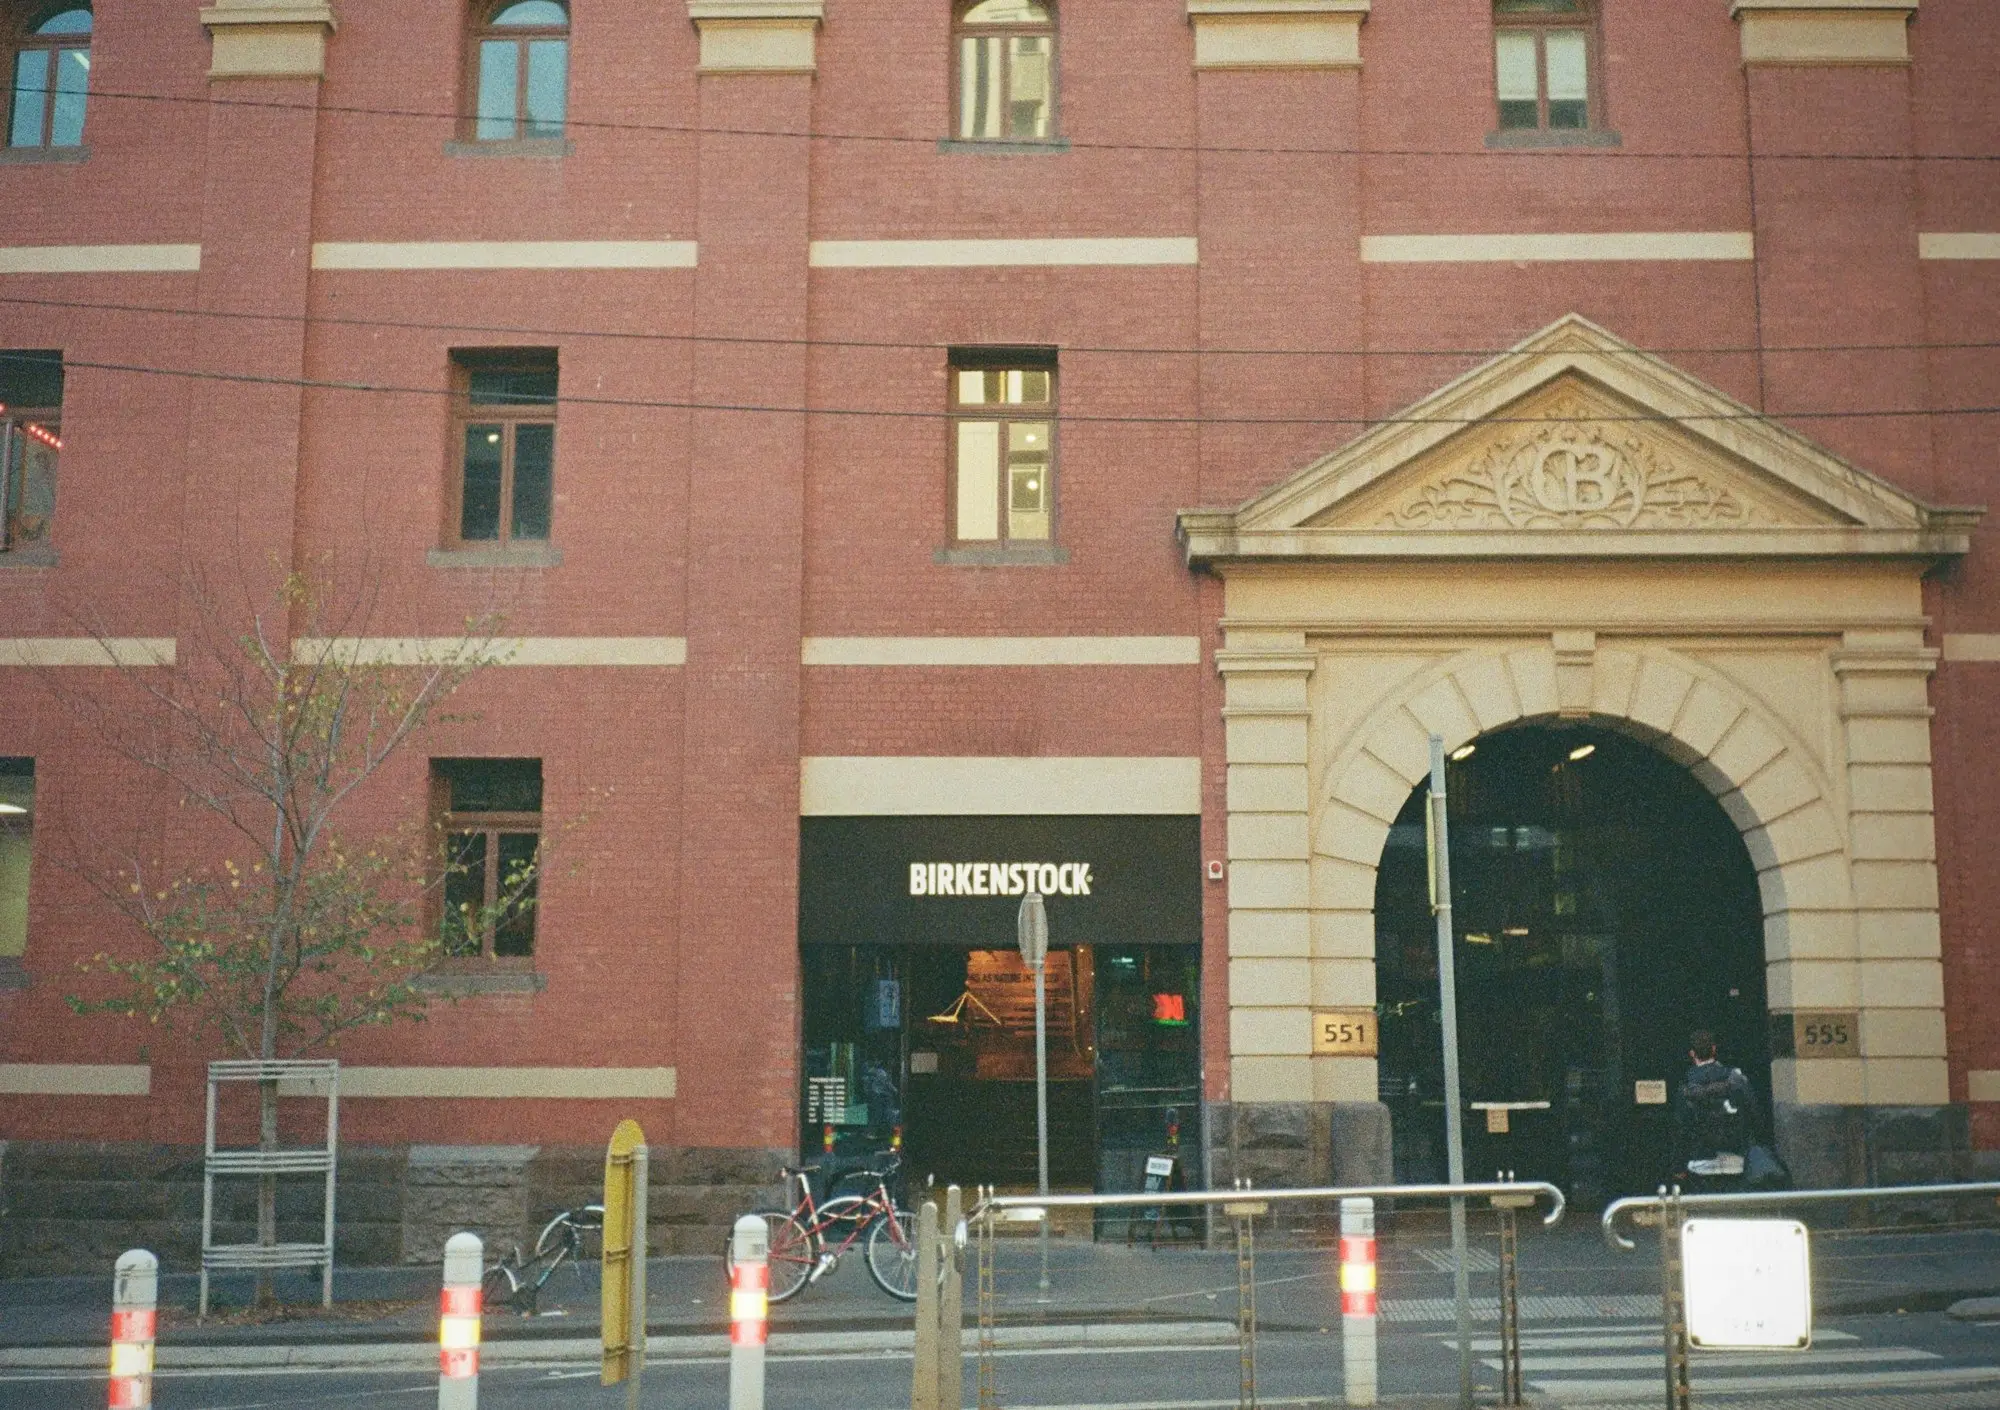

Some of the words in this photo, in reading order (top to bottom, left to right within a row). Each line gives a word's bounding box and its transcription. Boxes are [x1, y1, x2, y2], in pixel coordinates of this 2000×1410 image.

[910, 862, 1091, 895] BIRKENSTOCK
[1325, 1023, 1364, 1042] 551
[1805, 1023, 1848, 1045] 555
